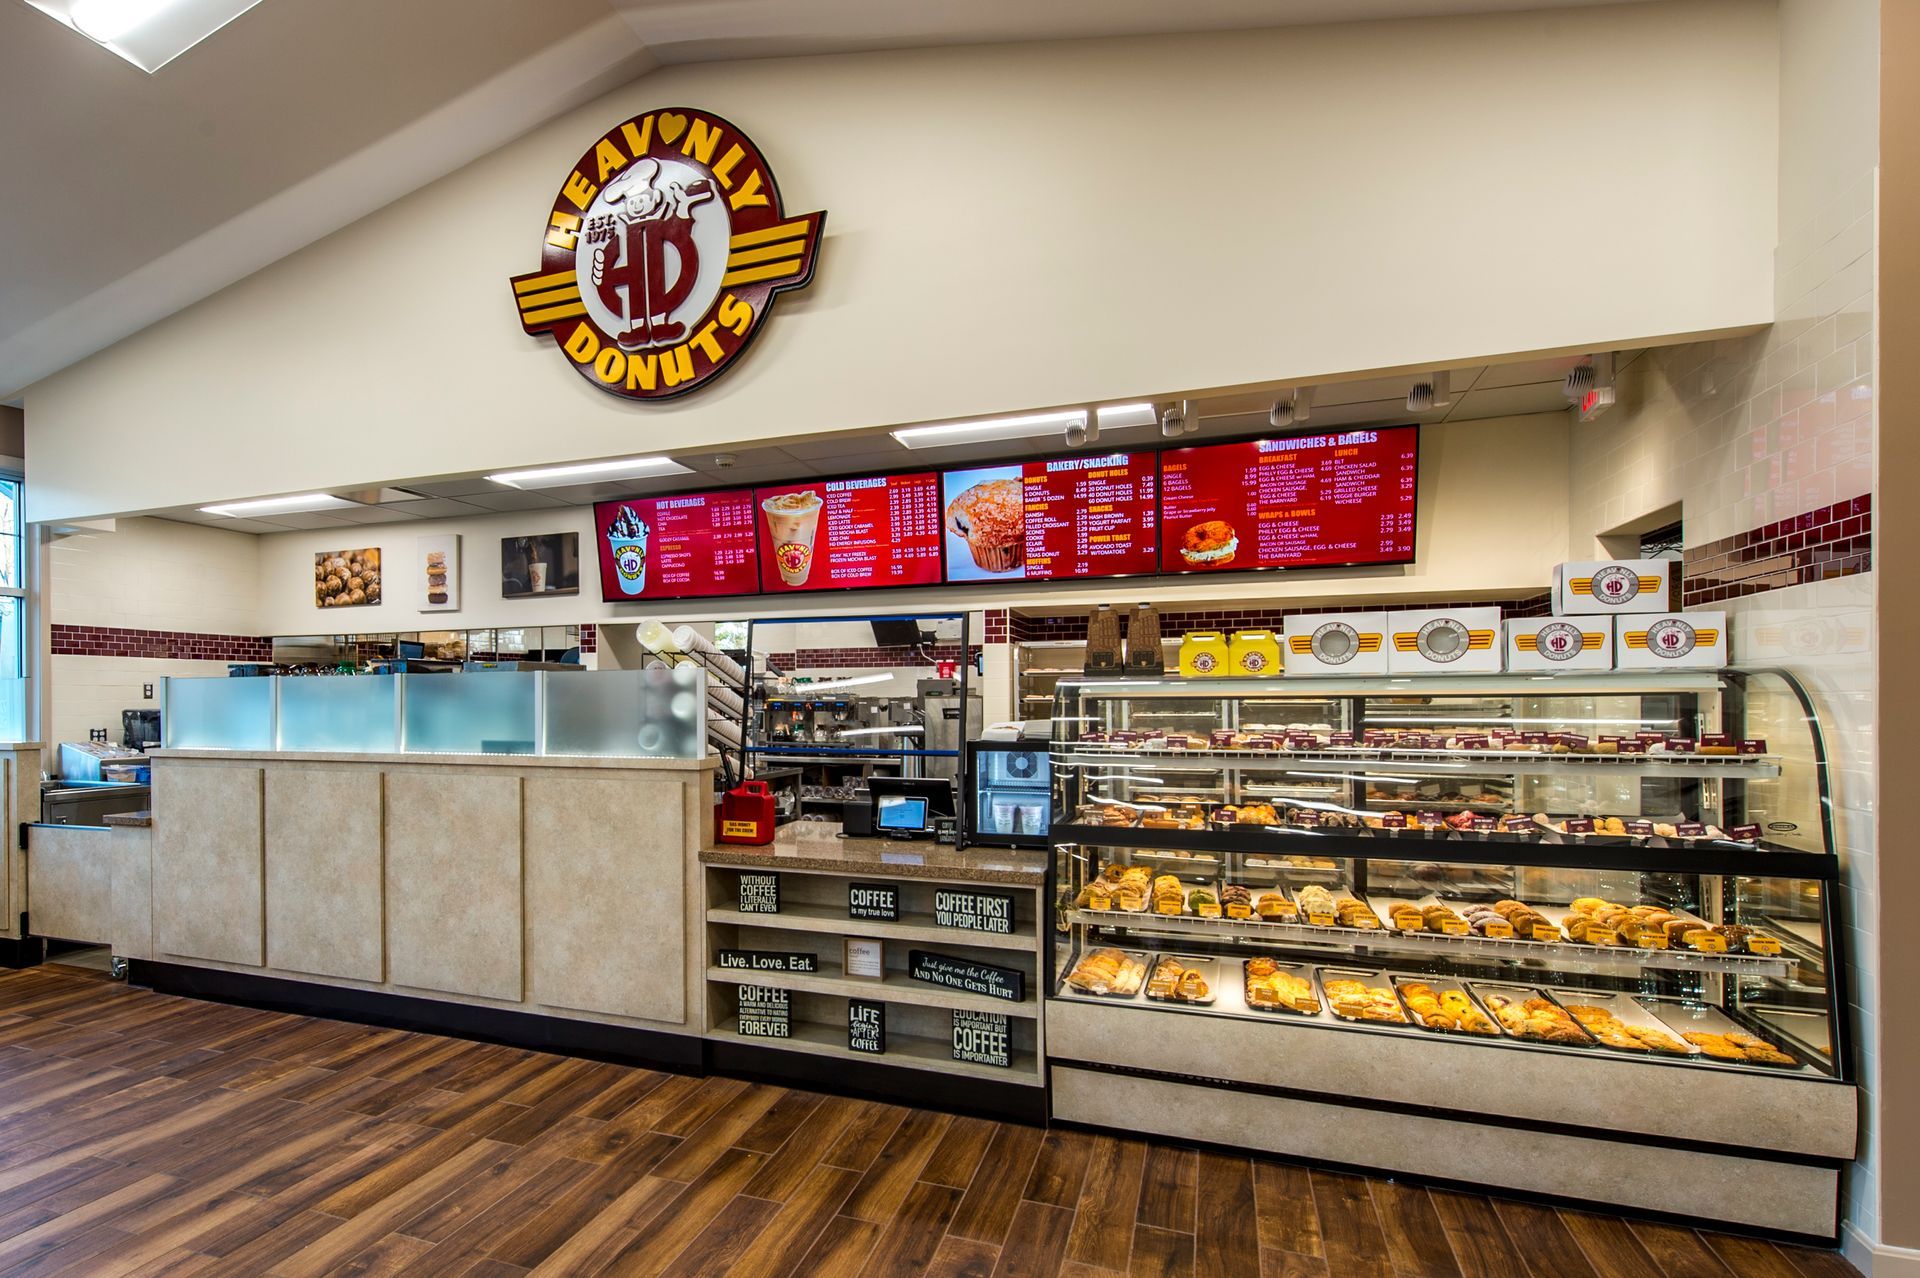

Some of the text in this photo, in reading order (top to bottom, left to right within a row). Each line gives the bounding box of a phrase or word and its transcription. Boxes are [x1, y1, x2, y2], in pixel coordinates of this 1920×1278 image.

[588, 214, 616, 230] EST.
[585, 227, 616, 244] 1975
[564, 294, 754, 390] DONUTS
[1259, 432, 1377, 452] SANDWICHES & BAGELS
[1259, 454, 1297, 463] BREAKFAST
[1335, 448, 1358, 457] LUNCH
[1047, 456, 1128, 472] BAKERY/SNACKING
[1088, 469, 1128, 478] DONUT HOLES
[826, 478, 887, 492] COLD BEVERAGES
[656, 498, 705, 510] HOT BEVERAGES
[1606, 581, 1623, 592] HD
[1551, 637, 1567, 649] HD
[1662, 634, 1679, 646] HD
[740, 875, 776, 885] WITHOUT
[740, 884, 776, 896] COFFEE
[744, 896, 776, 904] LITERALLY
[850, 889, 894, 908] COFFEE
[936, 892, 1009, 918] COFFEE FIRST
[760, 904, 777, 912] EVEN
[851, 906, 857, 914] is
[858, 908, 867, 916] my
[881, 909, 894, 917] love
[936, 910, 1008, 933] YOU PEOPLE LATER
[849, 946, 870, 955] coffee
[721, 954, 813, 970] Live. Love. Eat.
[922, 957, 937, 968] Just
[939, 963, 953, 972] give
[966, 968, 979, 978] the
[980, 970, 1004, 983] Coffee
[739, 985, 788, 1003] COFFEE
[739, 1020, 788, 1037] FOREVER
[961, 1020, 993, 1031] IMPORTANT
[995, 1024, 1007, 1033] BUT
[851, 1038, 879, 1050] COFFEE
[953, 1027, 1007, 1057] COFFEE
[954, 1049, 1008, 1066] IS IMPORTANTER
